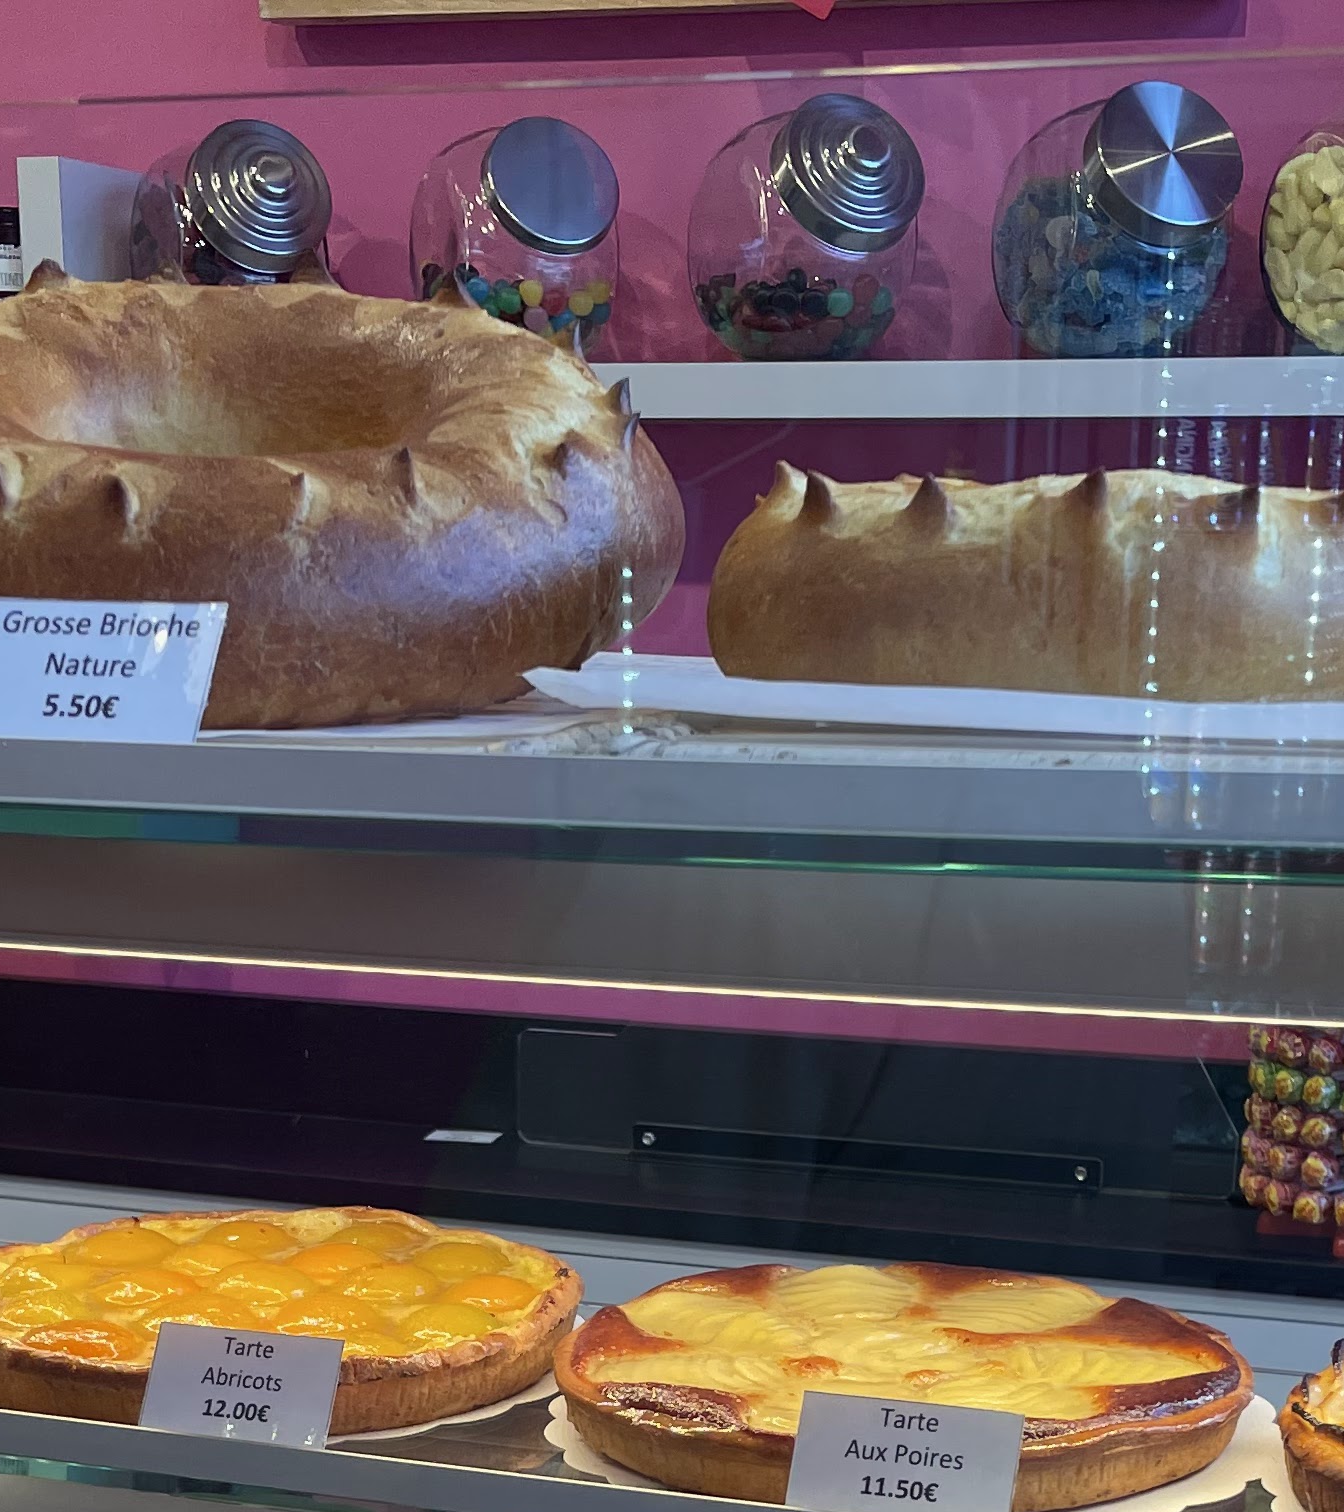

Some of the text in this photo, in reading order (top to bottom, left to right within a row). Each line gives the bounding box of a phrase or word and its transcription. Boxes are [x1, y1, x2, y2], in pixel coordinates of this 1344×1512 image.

[2, 610, 201, 639] Grosse Brioche
[44, 652, 136, 678] Nature
[42, 694, 120, 718] 5.50€
[224, 1336, 274, 1360] Tarte
[201, 1367, 283, 1393] Abricots
[202, 1399, 271, 1423] 12.00€
[880, 1407, 939, 1433] Tarte
[844, 1439, 964, 1471] Aux Poires
[860, 1475, 940, 1503] 11.50€
